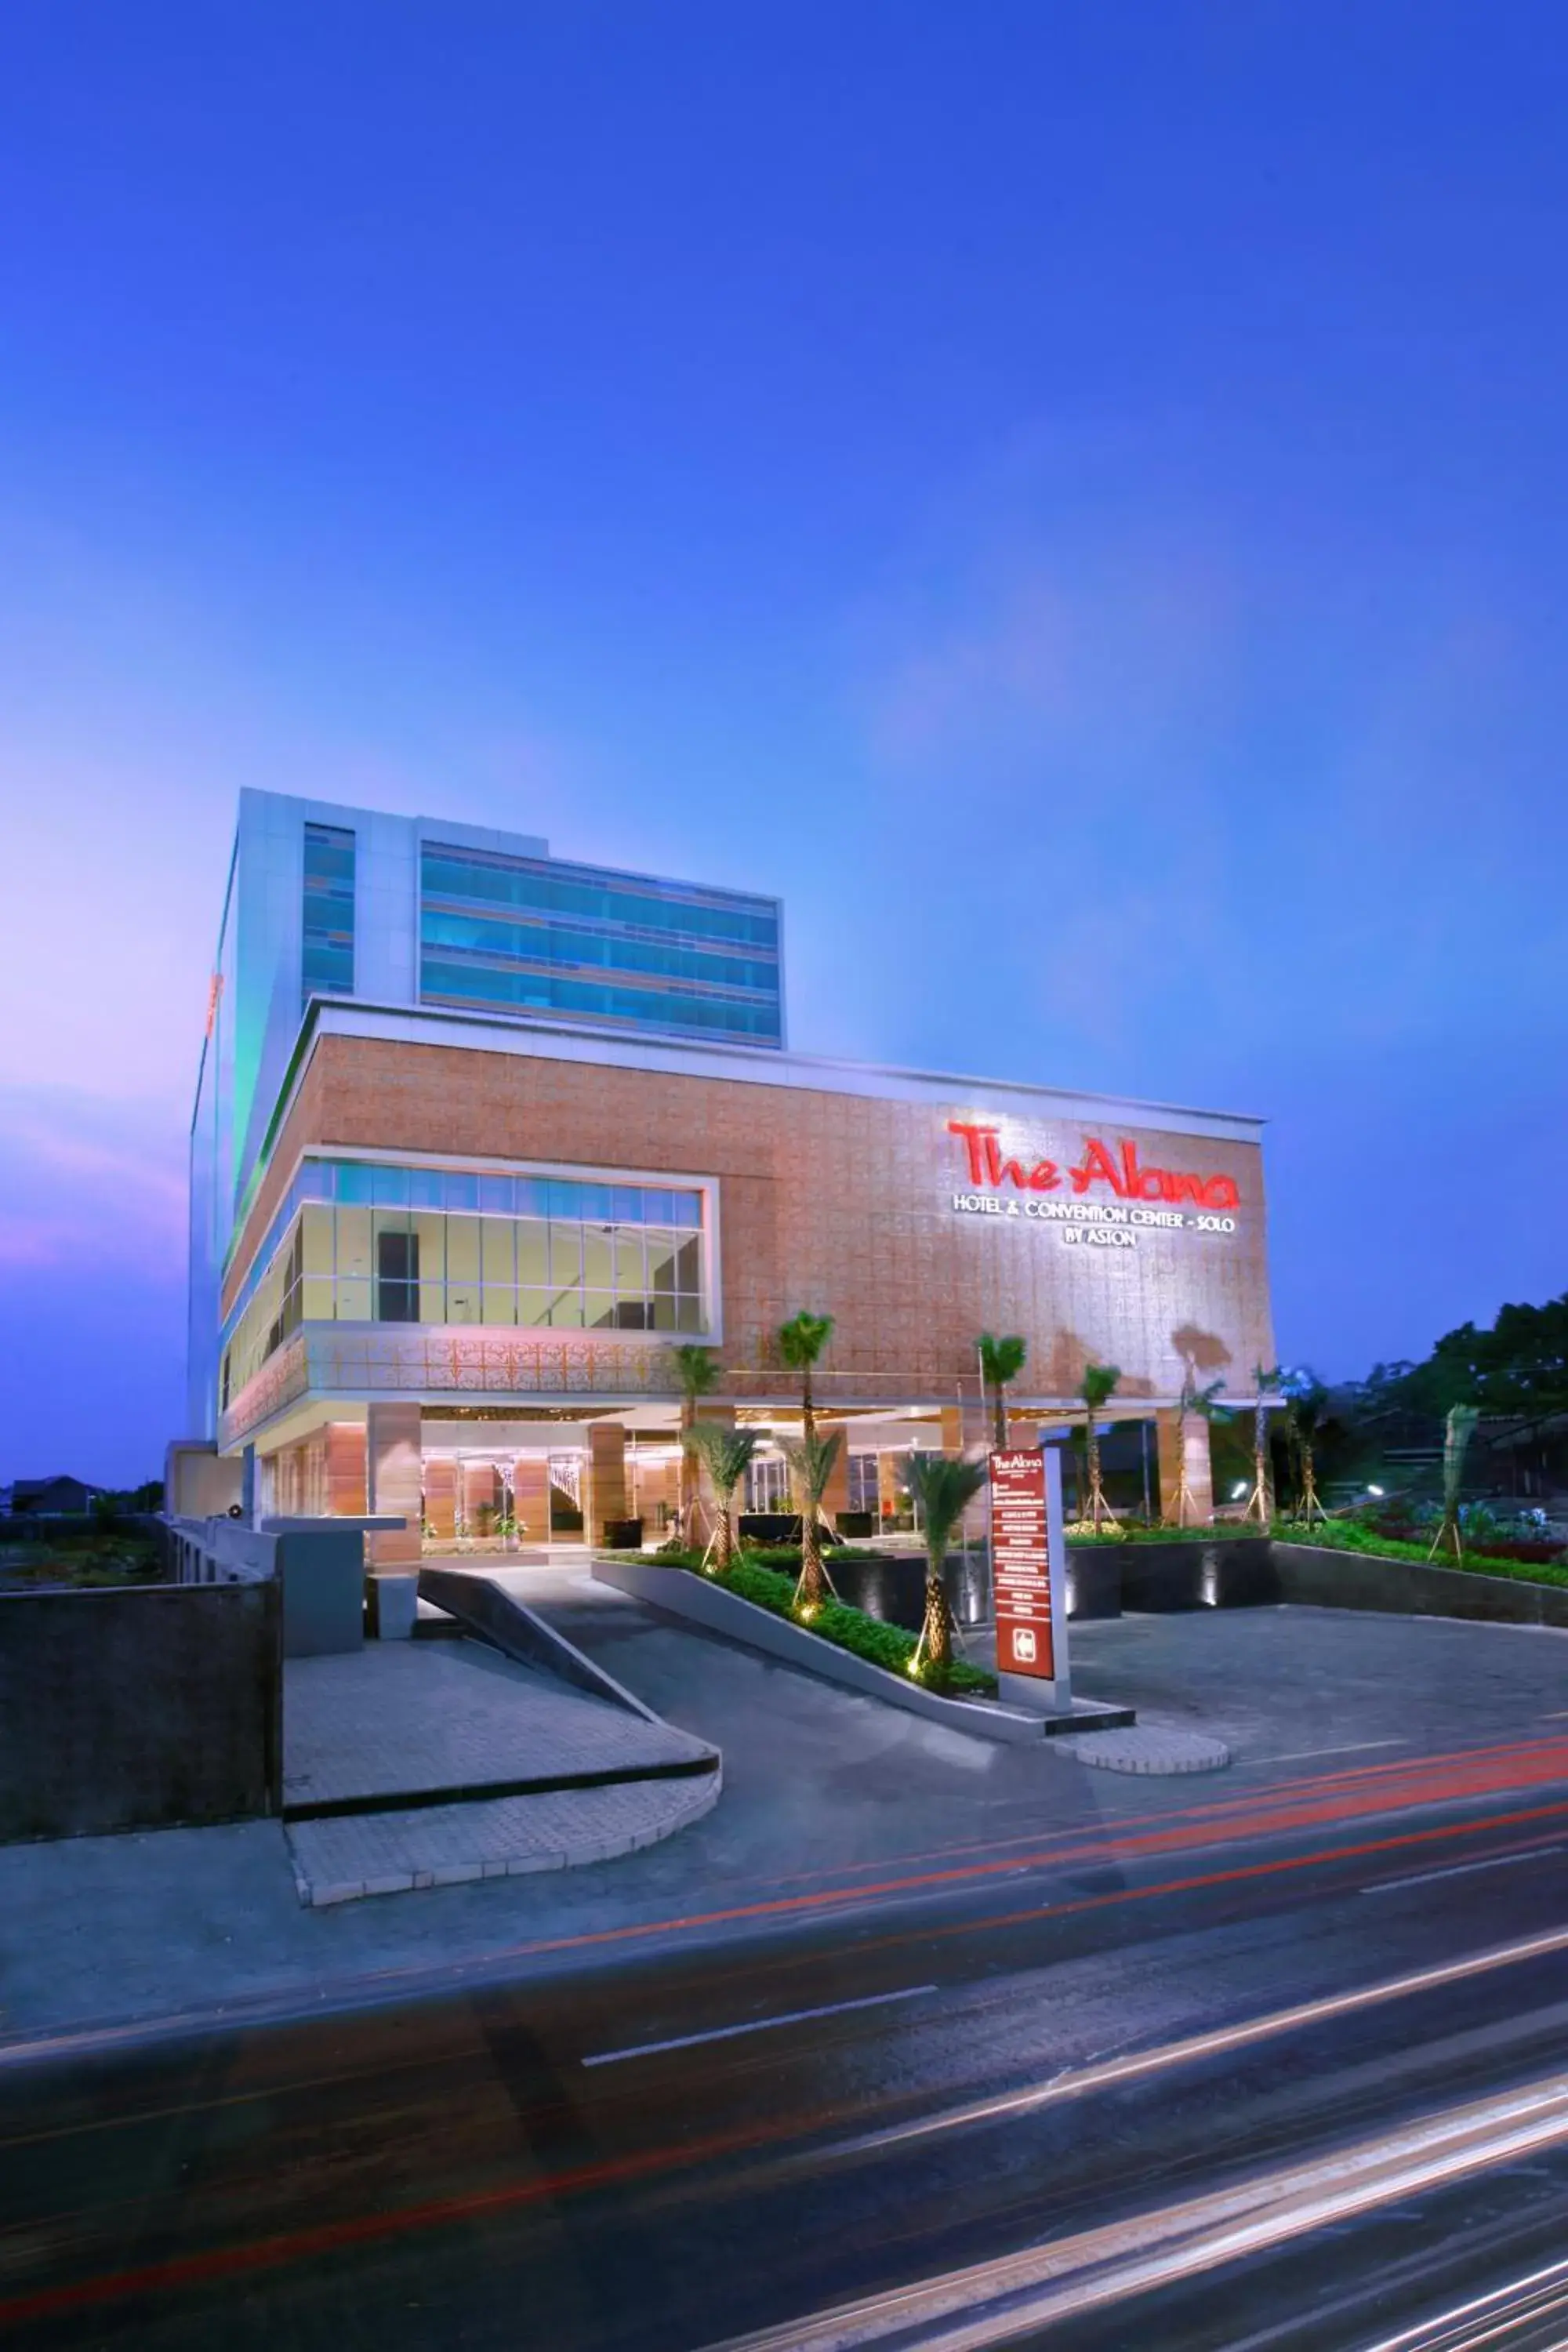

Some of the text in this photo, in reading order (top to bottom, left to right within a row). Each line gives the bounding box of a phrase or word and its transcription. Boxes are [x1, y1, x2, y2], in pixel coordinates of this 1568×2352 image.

[946, 1121, 1240, 1210] The Alana
[953, 1195, 1004, 1214] HOTEL
[1007, 1201, 1019, 1215] &
[1025, 1201, 1127, 1224] CONVENTION
[1131, 1210, 1182, 1229] CENTER
[1197, 1216, 1235, 1233] SOLO
[1065, 1228, 1136, 1247] BY ASTON
[992, 1454, 1042, 1468] The Alana
